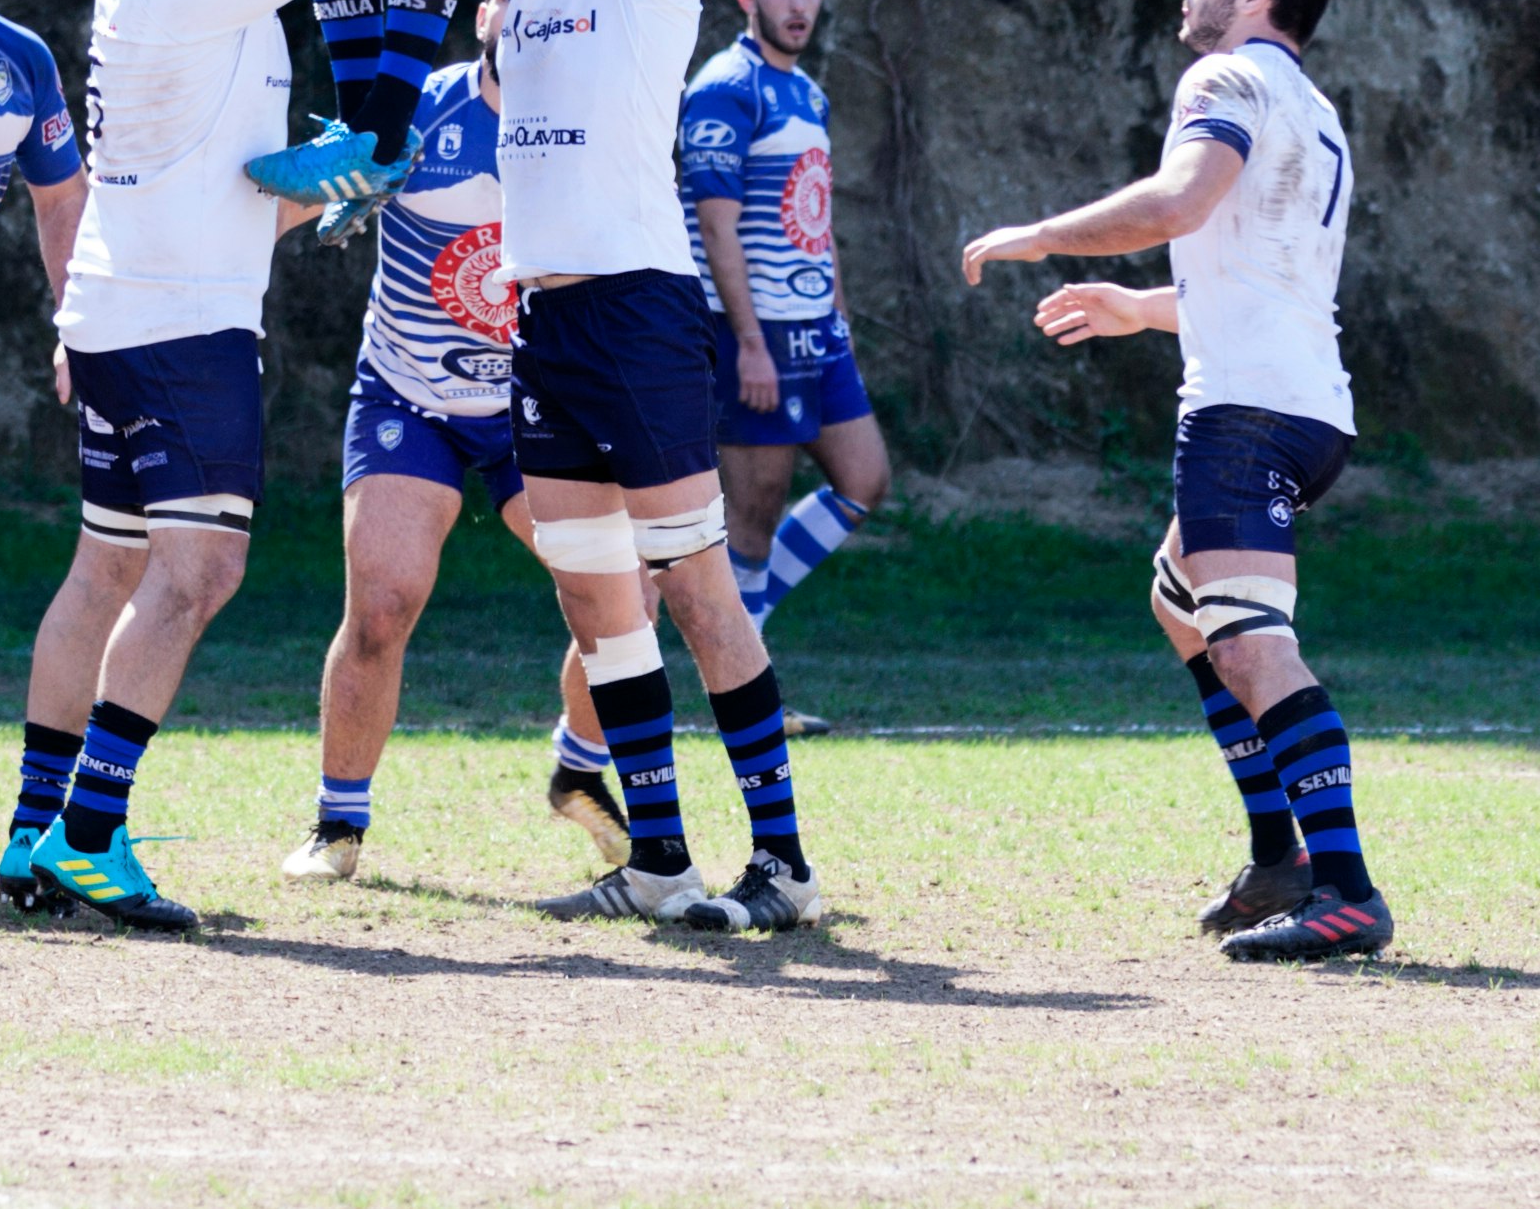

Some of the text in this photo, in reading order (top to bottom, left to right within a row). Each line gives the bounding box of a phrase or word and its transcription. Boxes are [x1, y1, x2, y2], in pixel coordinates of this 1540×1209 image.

[524, 9, 596, 43] Cajasol
[515, 126, 586, 147] OLAVIDE
[421, 166, 474, 176] MARBELLA
[1318, 119, 1344, 218] 7
[788, 330, 827, 358] HC
